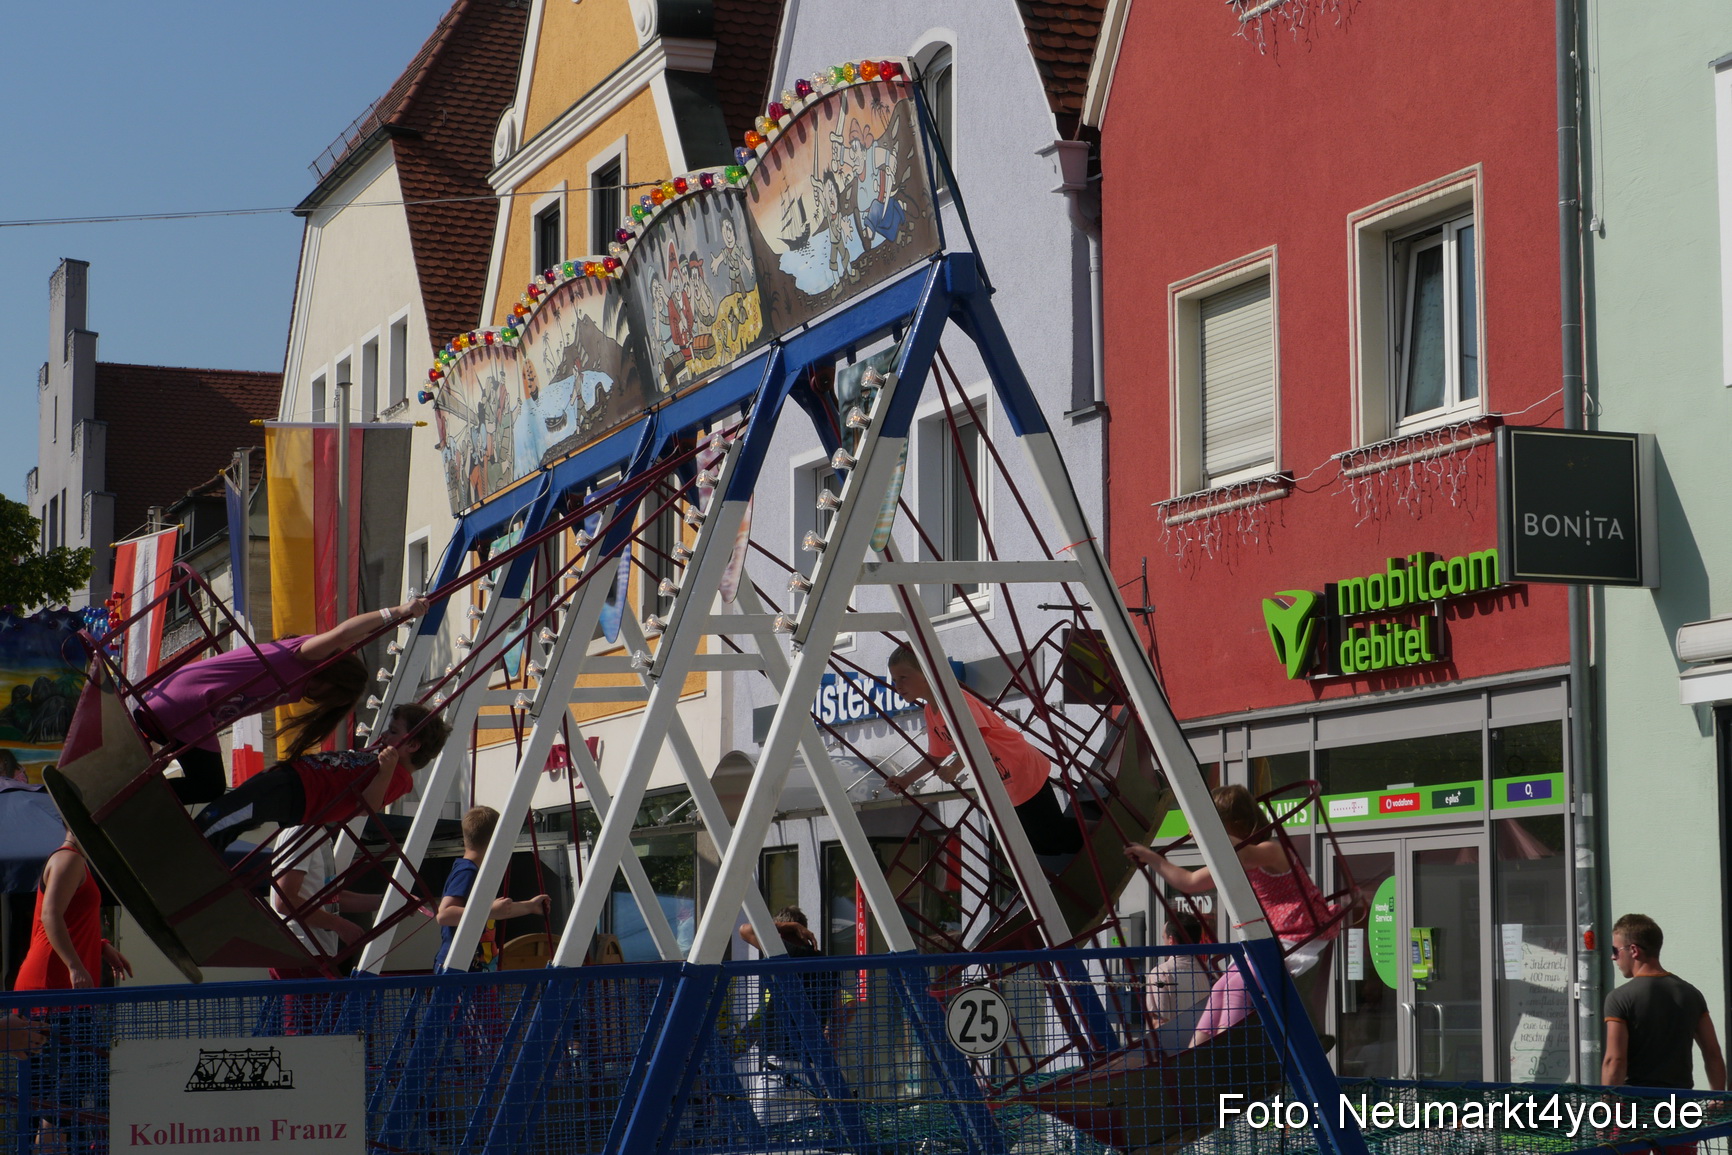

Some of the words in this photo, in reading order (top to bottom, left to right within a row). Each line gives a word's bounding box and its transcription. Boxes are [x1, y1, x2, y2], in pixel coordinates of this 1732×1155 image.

[1338, 548, 1500, 616] mobilcom
[1340, 615, 1436, 674] debitel
[959, 999, 999, 1043] 25
[128, 1122, 261, 1147] Kollmann
[270, 1118, 348, 1142] Franz
